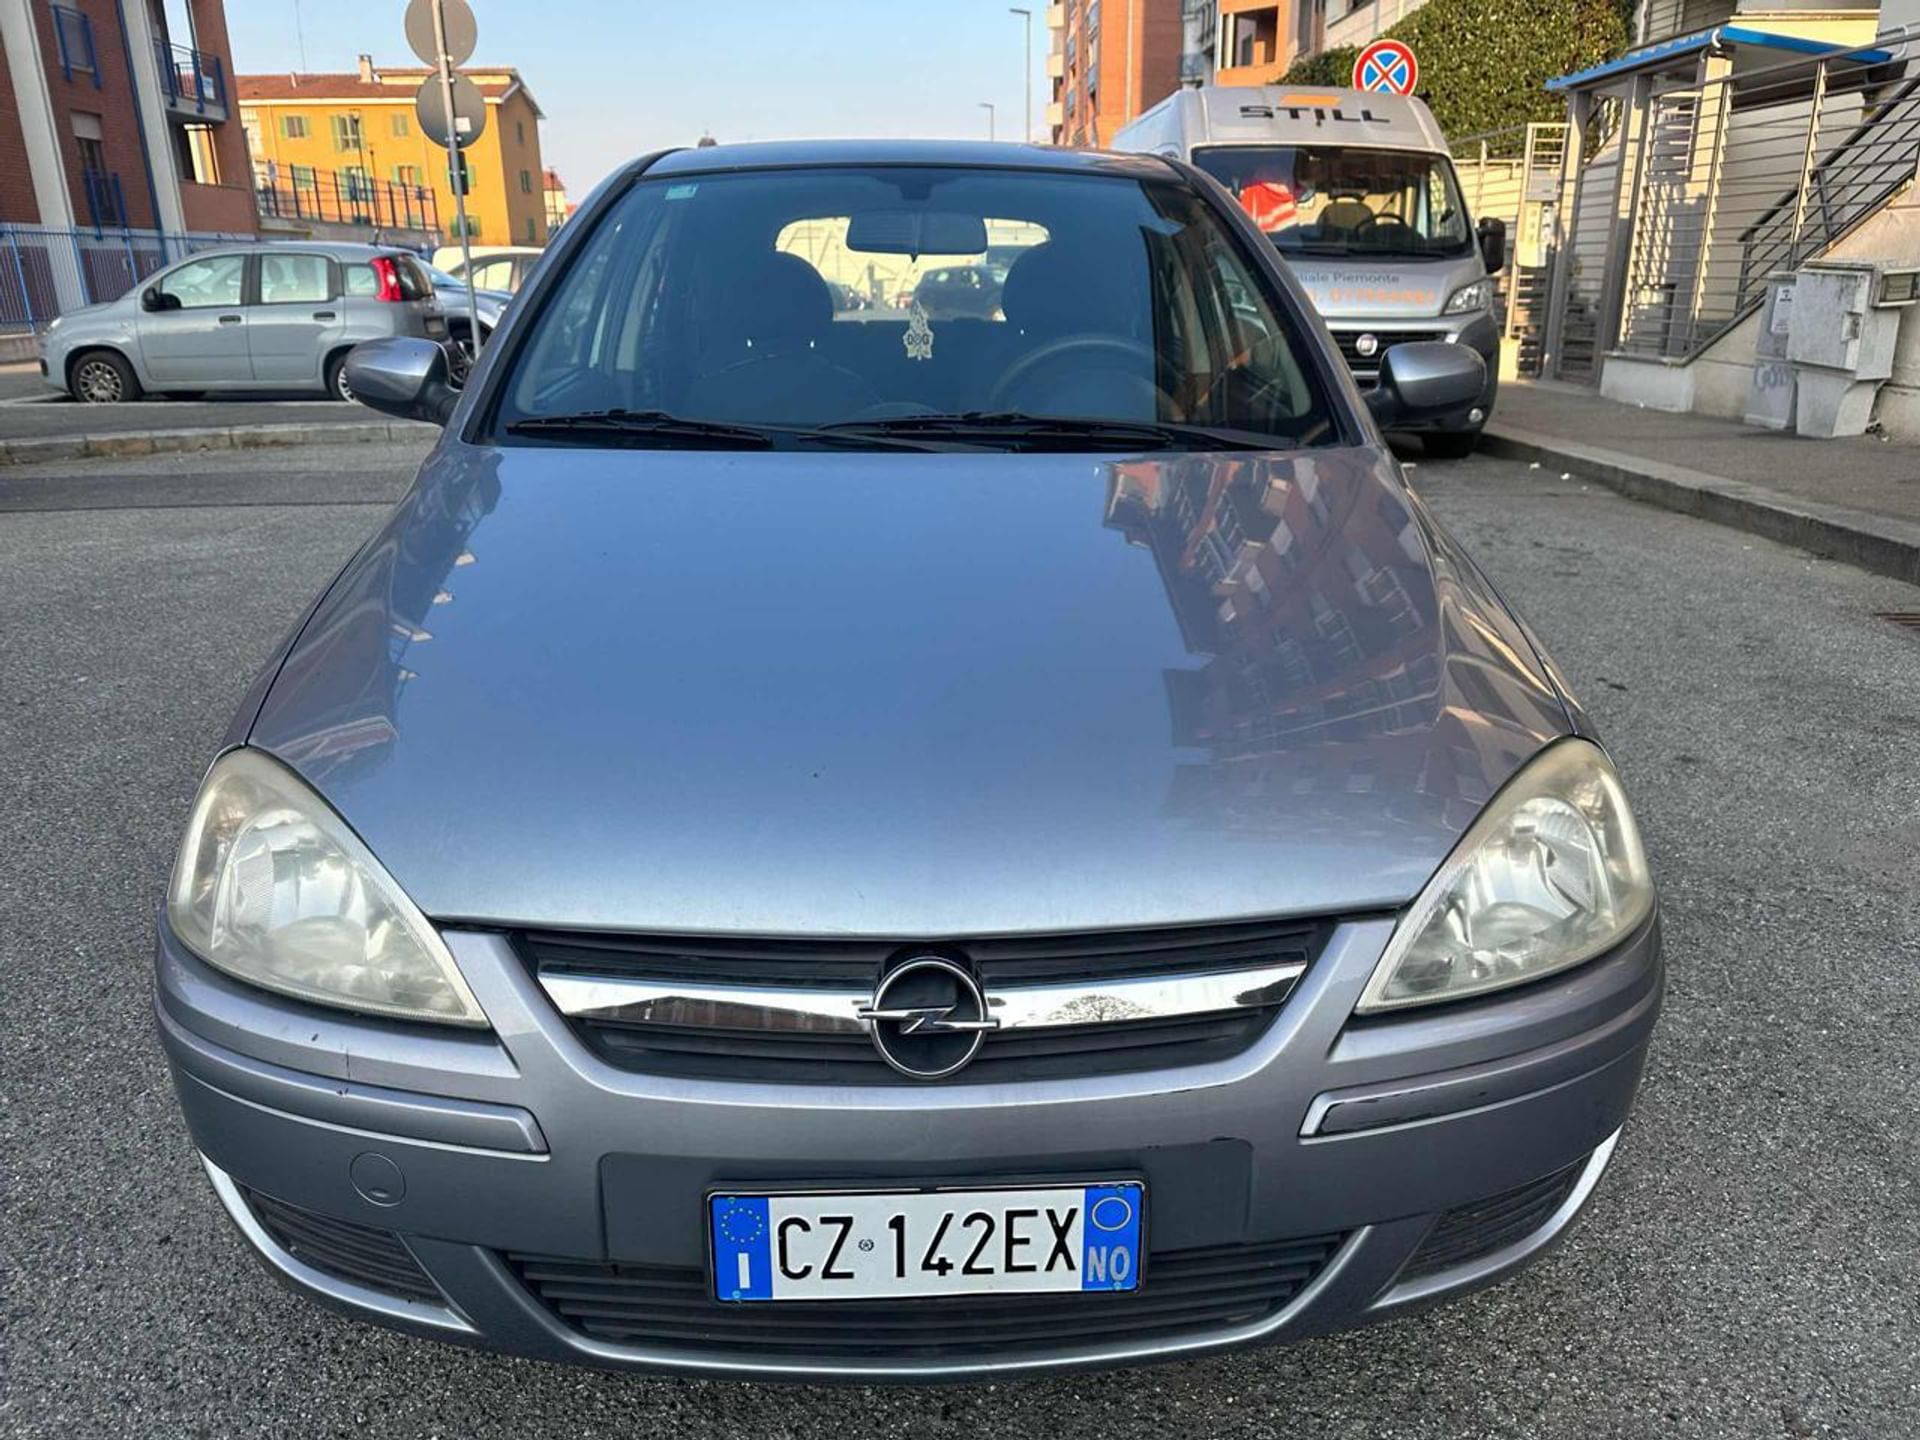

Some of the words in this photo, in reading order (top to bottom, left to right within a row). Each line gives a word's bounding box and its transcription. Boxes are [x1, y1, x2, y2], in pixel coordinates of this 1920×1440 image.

[1240, 106, 1390, 127] STILL
[1333, 273, 1400, 283] Piemonte
[777, 1216, 855, 1280] CZ
[889, 1207, 1079, 1279] 142EX
[738, 1253, 750, 1289] I
[1088, 1245, 1130, 1283] NO
